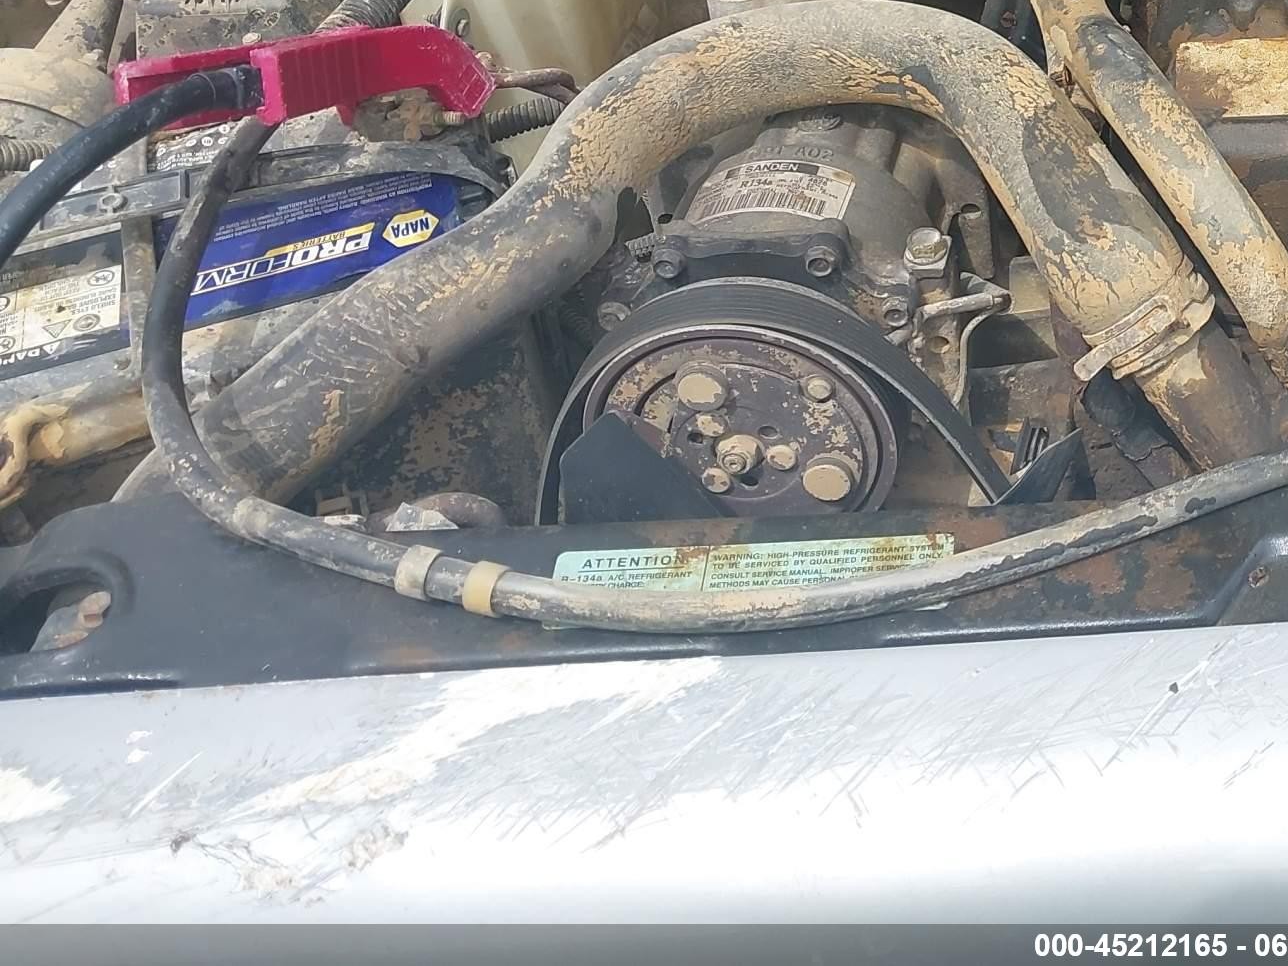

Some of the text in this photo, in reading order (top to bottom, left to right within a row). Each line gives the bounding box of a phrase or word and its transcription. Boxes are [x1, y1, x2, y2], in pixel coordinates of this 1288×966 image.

[744, 163, 799, 174] SANDEN
[390, 217, 431, 239] NAPA
[292, 230, 347, 252] BATTERIES
[192, 231, 374, 296] PROFORM
[713, 543, 945, 562] WARNING: HIGH-PRESSURE REFRIGERANT SYSTEM
[728, 561, 741, 569] BE
[744, 560, 789, 569] SERVICED
[793, 558, 806, 567] BY
[809, 556, 858, 566] QUALIFIED
[860, 554, 916, 564] PERSONNEL
[918, 552, 945, 560] ONLY.
[607, 573, 625, 582] A/C
[628, 571, 693, 581] REFRIGERANT
[711, 571, 750, 580] CONSULT
[751, 570, 788, 578] SERVICE
[789, 568, 828, 577] MANUAL.
[830, 565, 875, 575] IMPROPER
[709, 580, 751, 589] METHODS
[752, 579, 770, 588] MAY
[771, 578, 801, 587] CAUSE
